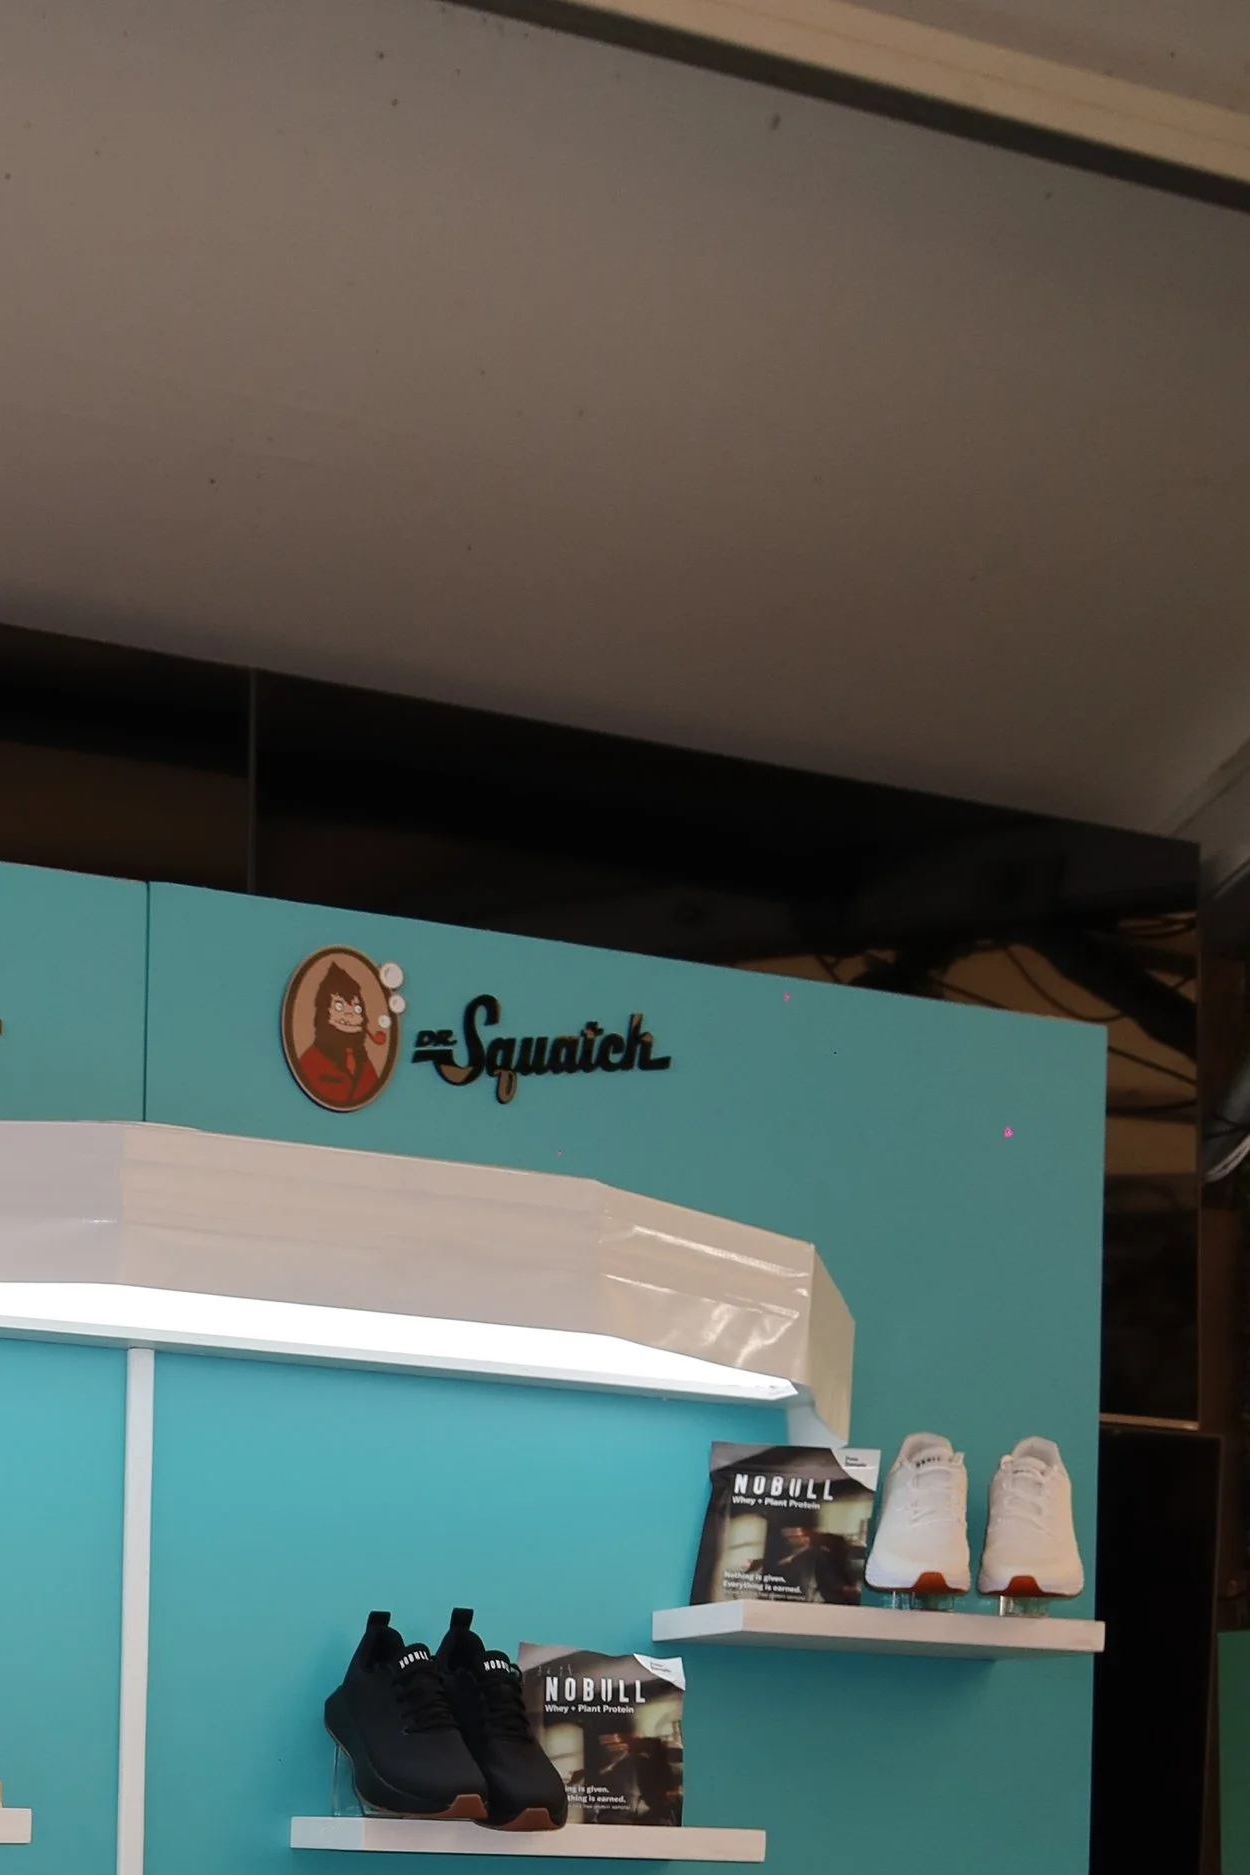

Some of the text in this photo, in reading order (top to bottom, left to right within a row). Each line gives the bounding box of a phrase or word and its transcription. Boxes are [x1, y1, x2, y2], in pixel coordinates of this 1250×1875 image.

[411, 994, 672, 1105] Squatch
[734, 1473, 834, 1501] NOBULL
[732, 1495, 756, 1507] Whey
[764, 1497, 788, 1508] Plant
[789, 1499, 821, 1510] Protein
[724, 1571, 754, 1582] Nothing
[723, 1580, 764, 1592] Everything
[773, 1584, 802, 1594] earned.
[545, 1676, 646, 1703] NOBULL
[545, 1704, 569, 1714] Whey
[578, 1704, 601, 1713] Plant
[602, 1705, 634, 1714] Protein
[586, 1786, 610, 1795] given.
[597, 1795, 626, 1803] earned.
